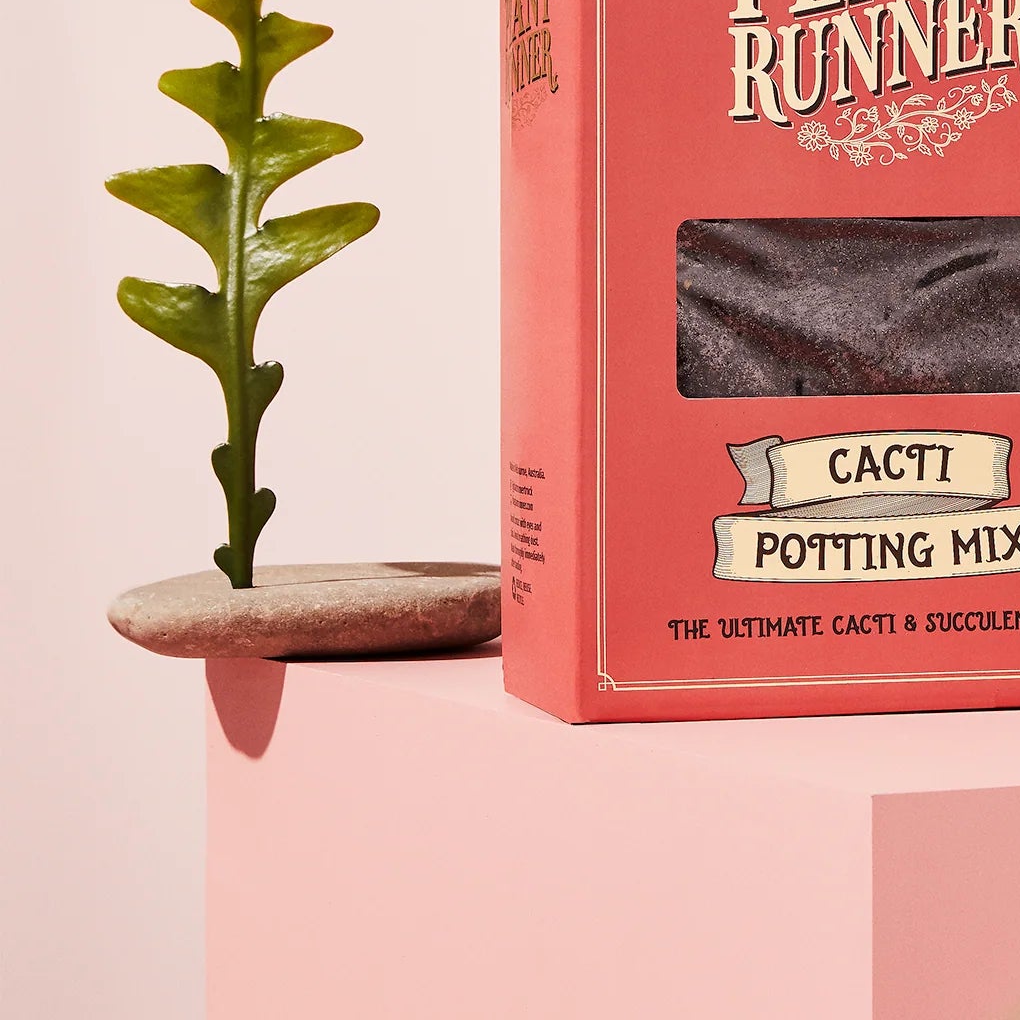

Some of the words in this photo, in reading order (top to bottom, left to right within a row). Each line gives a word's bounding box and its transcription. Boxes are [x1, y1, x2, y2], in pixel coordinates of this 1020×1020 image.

[828, 444, 955, 484] CACTI
[755, 532, 934, 571] POTTING
[668, 618, 711, 640] THE
[718, 615, 823, 638] ULTIMATE
[831, 613, 897, 636] CACTI
[904, 615, 917, 632] &
